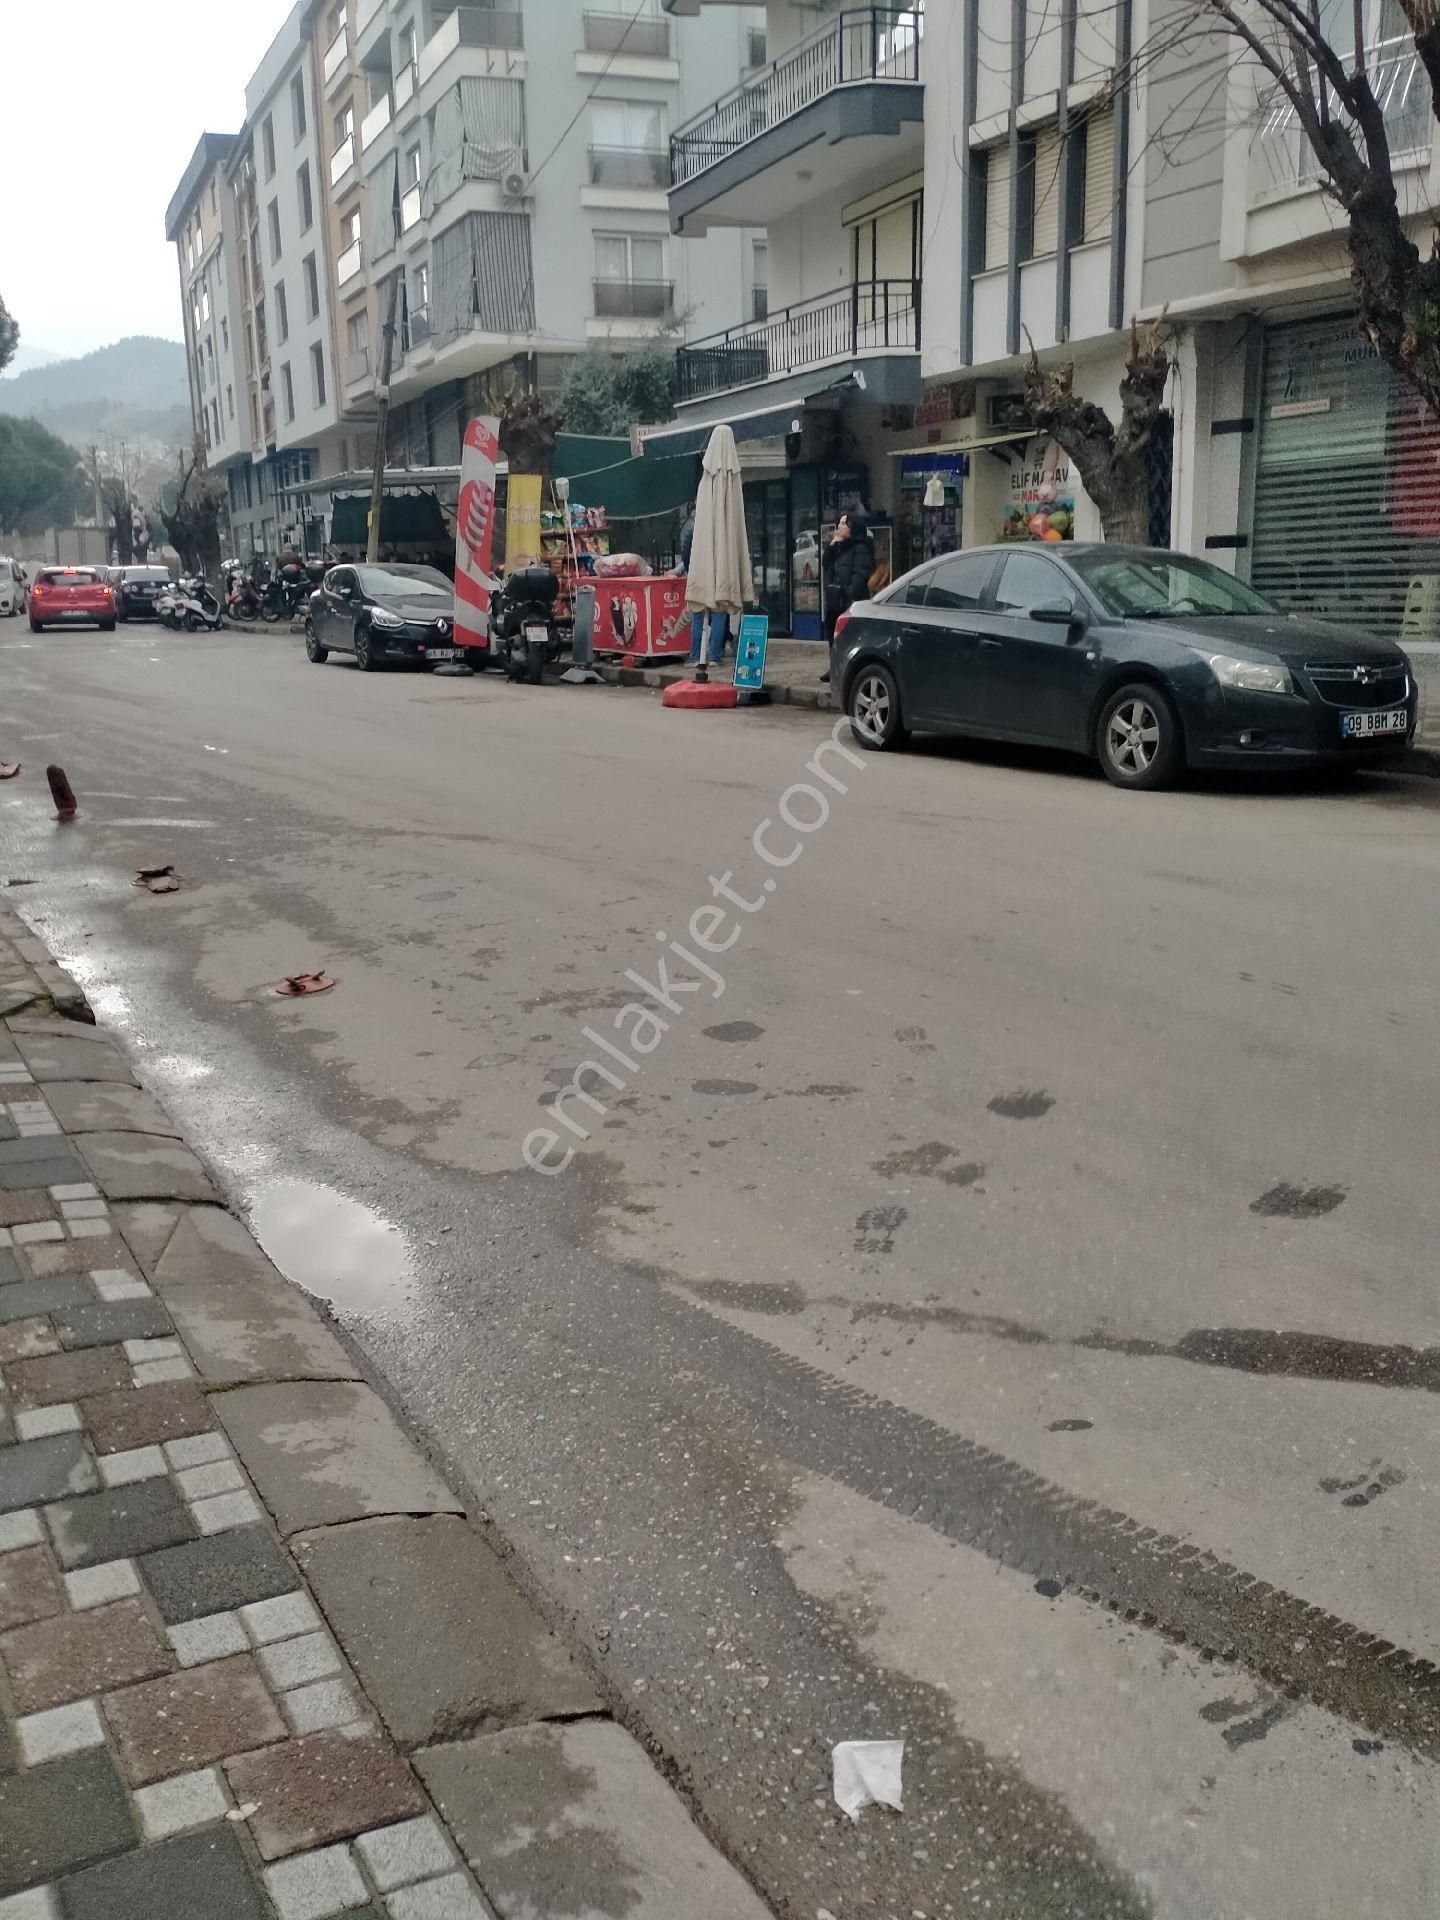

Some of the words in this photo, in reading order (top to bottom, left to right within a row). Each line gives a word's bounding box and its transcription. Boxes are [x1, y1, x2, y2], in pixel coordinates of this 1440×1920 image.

[1011, 467, 1030, 489] ELİF
[1031, 467, 1069, 487] MAAV
[1348, 716, 1362, 731] 09
[1392, 711, 1405, 727] 28
